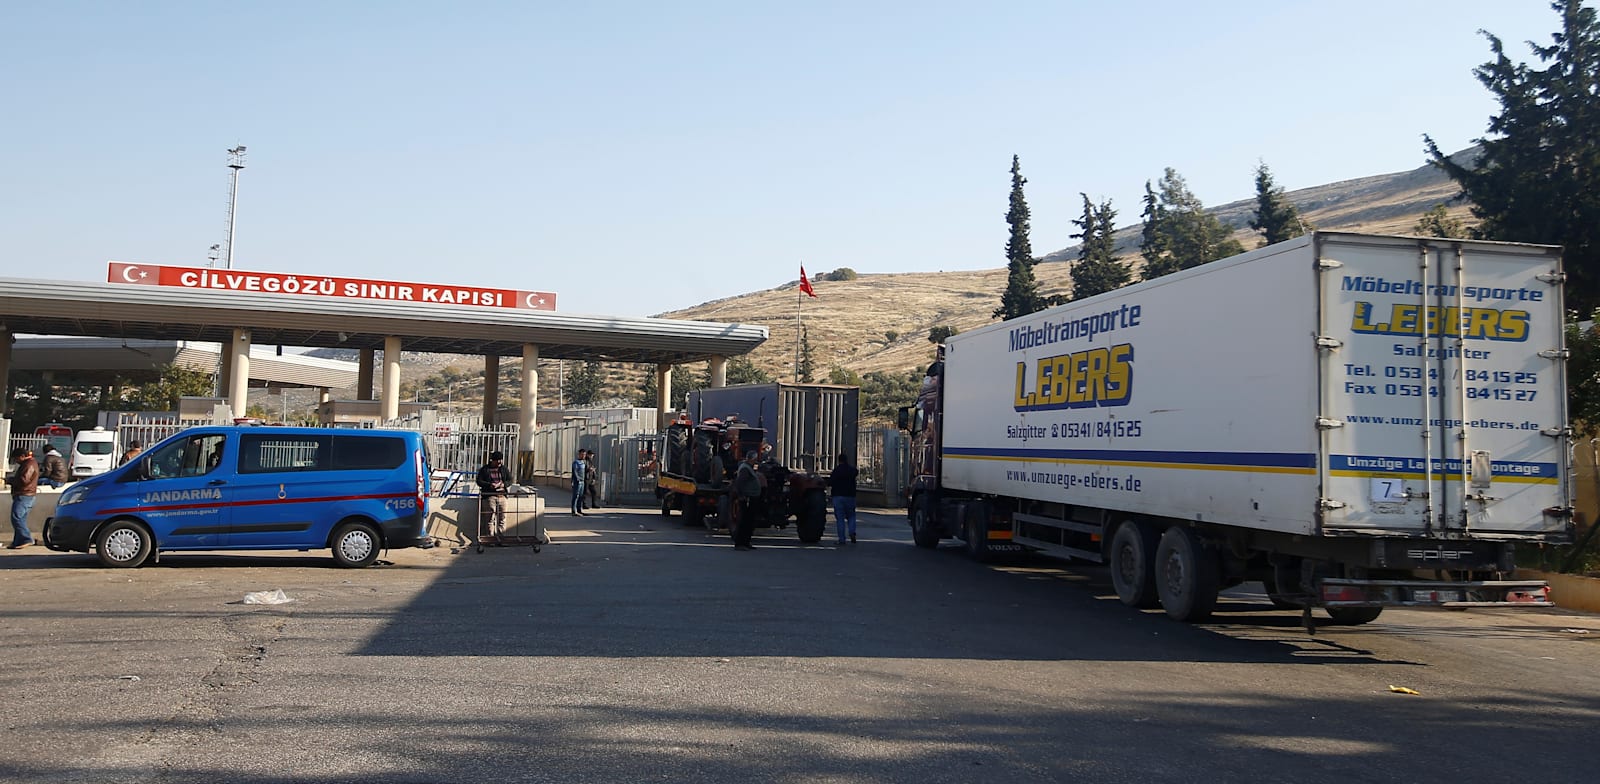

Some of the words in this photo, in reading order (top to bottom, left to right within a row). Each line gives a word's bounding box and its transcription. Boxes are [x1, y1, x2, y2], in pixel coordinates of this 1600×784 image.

[180, 270, 336, 295] CİLVEGÖZÜ
[344, 282, 413, 301] SINIR
[422, 287, 503, 307] KAPISI
[1341, 276, 1543, 302] Möbeltransporte
[1008, 304, 1142, 352] Möbeltransporte
[1351, 301, 1531, 343] L.EBERS
[1393, 343, 1491, 361] Salzgitter
[1013, 343, 1134, 413] L.EBERS
[1344, 363, 1376, 376] Tel.
[1344, 381, 1377, 395] Fax
[1007, 425, 1047, 442] Salzgitter
[1347, 456, 1404, 470] Umzüge
[1408, 458, 1473, 474] Laerug
[1490, 463, 1541, 476] ontage
[1006, 470, 1142, 492] www.umzuege-ebers.de
[1381, 481, 1392, 498] 7
[142, 487, 223, 503] JANDARMA
[393, 498, 416, 510] 156
